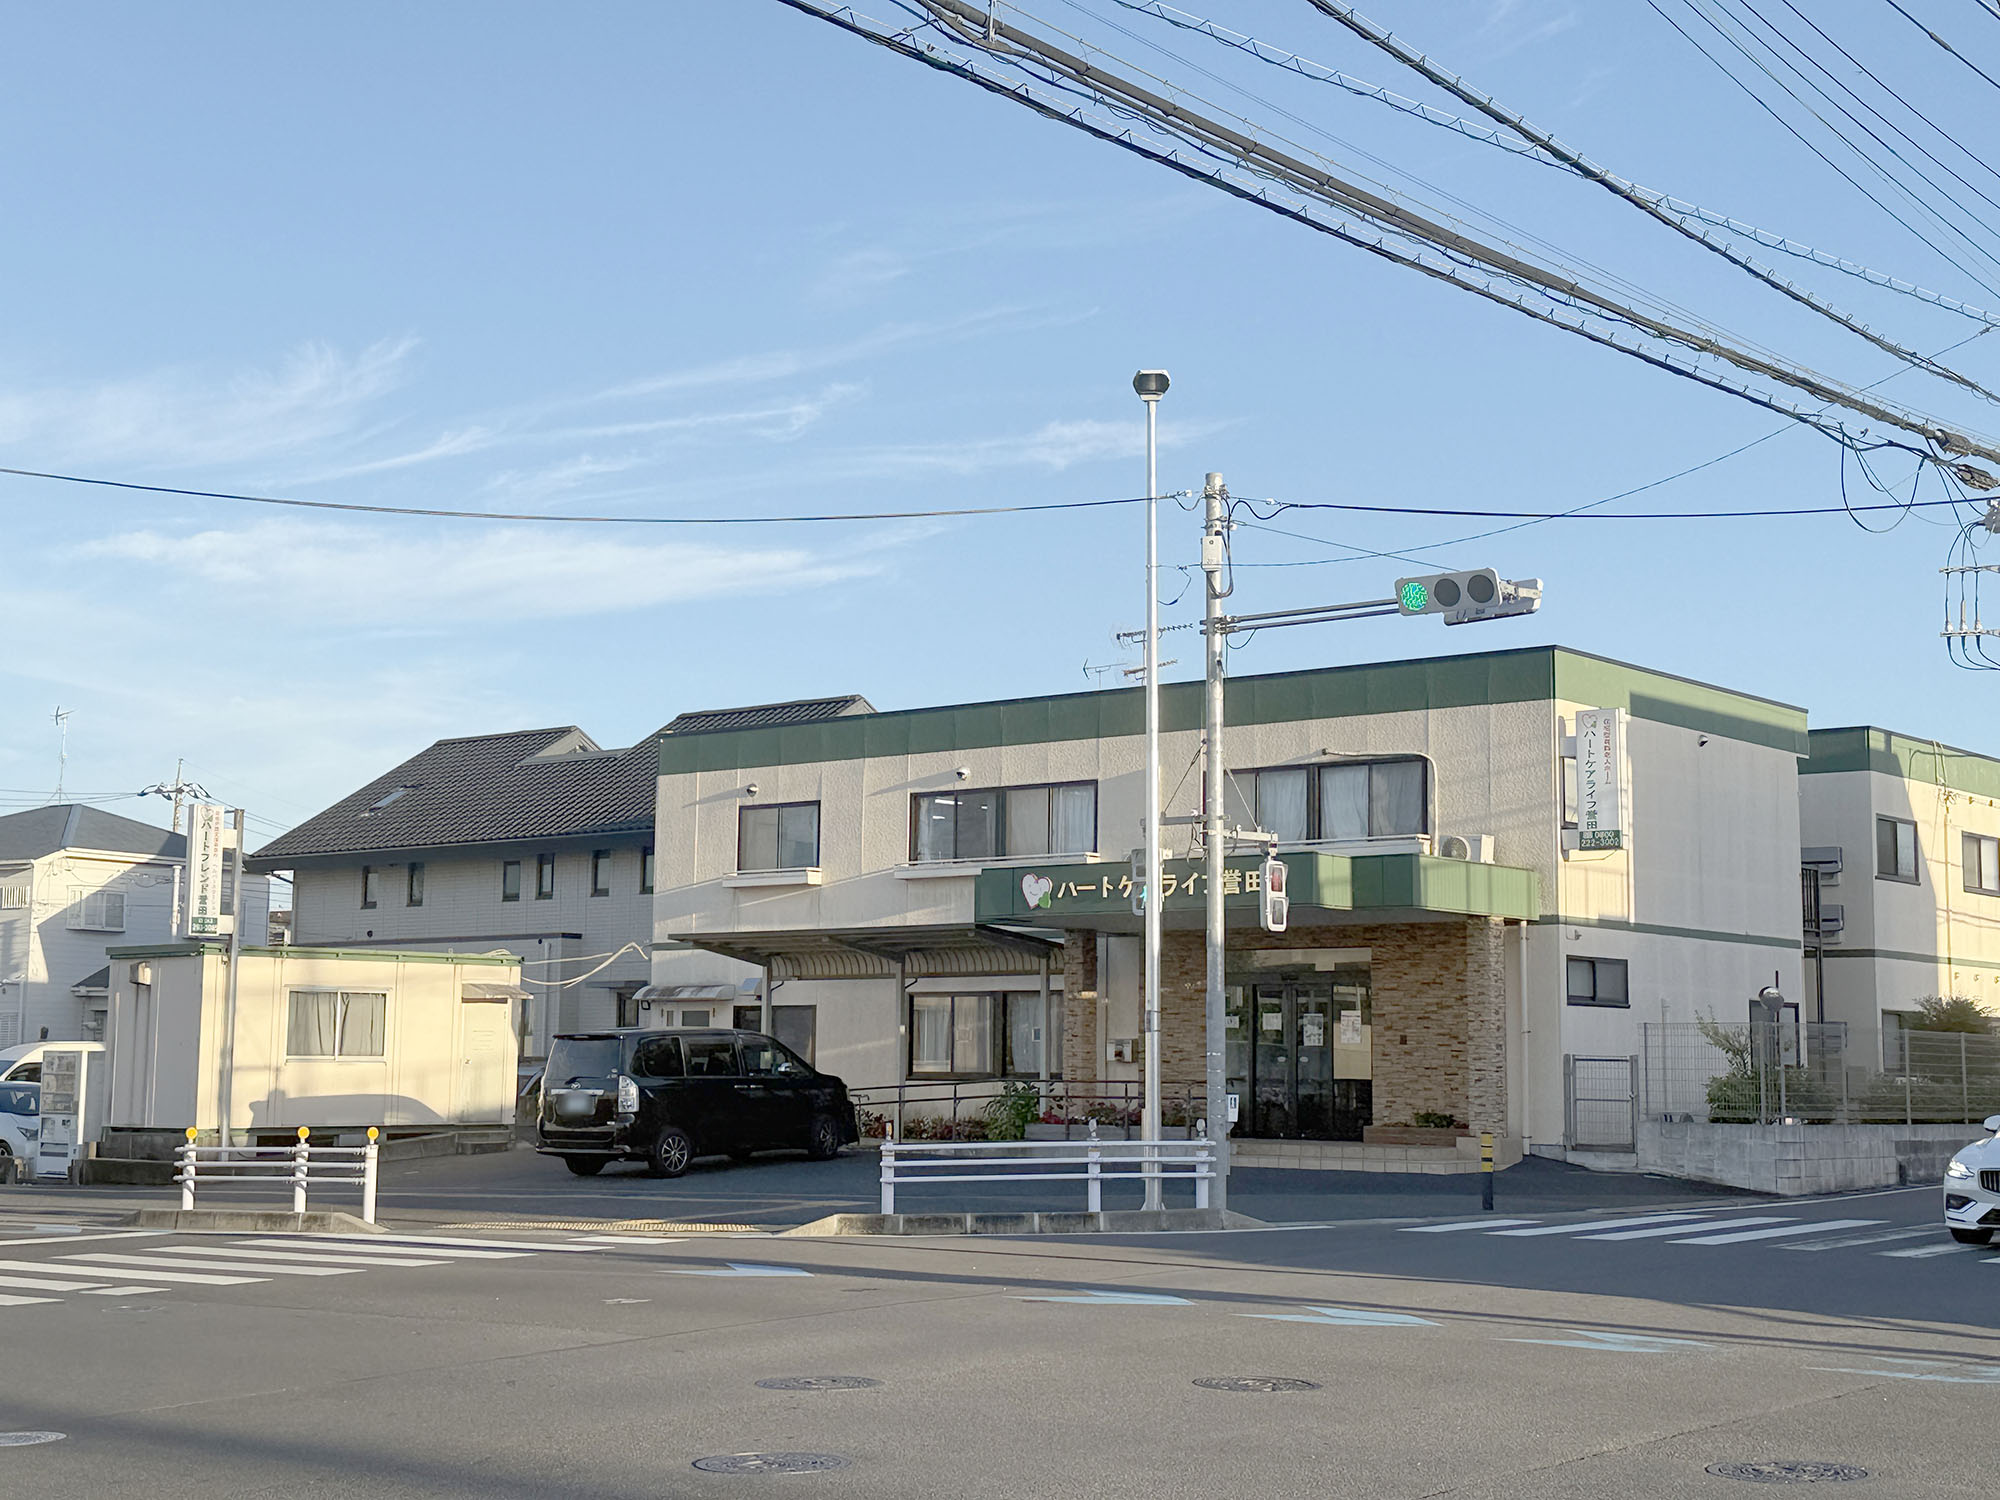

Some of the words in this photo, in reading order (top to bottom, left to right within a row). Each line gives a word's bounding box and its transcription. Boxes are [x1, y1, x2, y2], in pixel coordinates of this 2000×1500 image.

[1583, 730, 1598, 829] ハートケアライフ誉田
[1057, 869, 1260, 898] ハートケライ誉田
